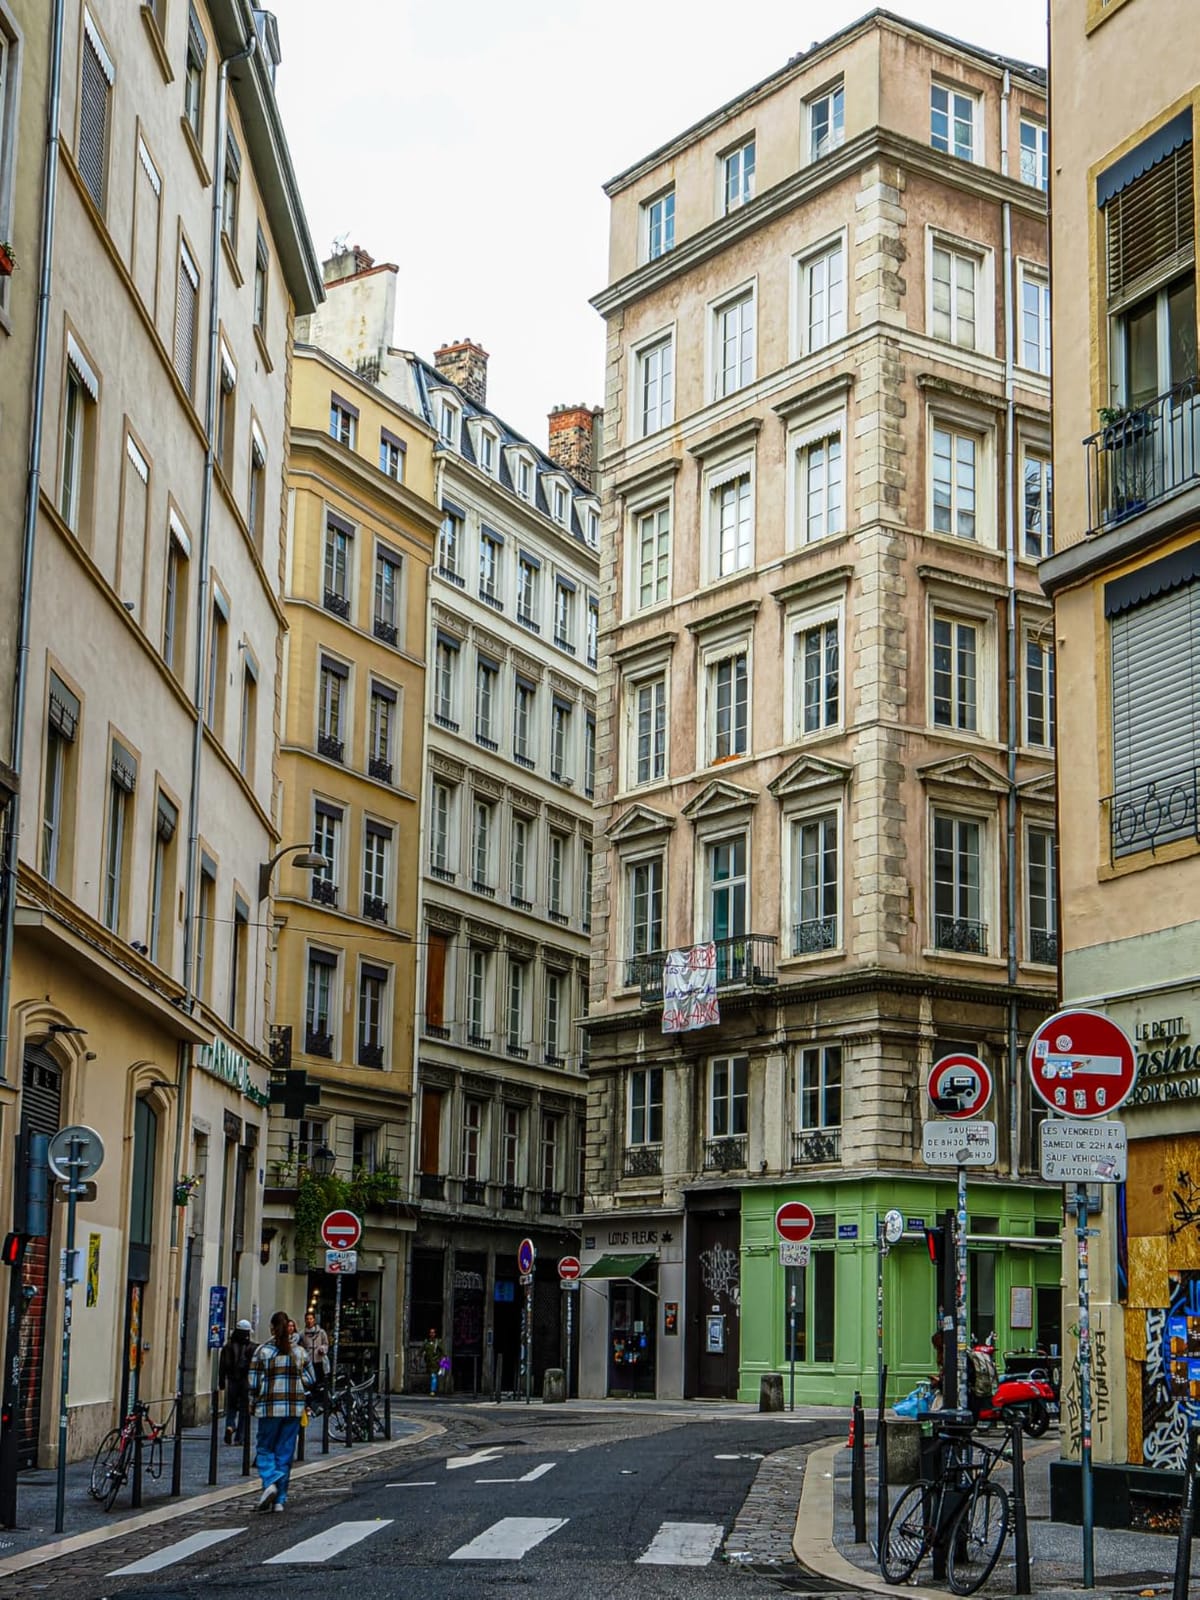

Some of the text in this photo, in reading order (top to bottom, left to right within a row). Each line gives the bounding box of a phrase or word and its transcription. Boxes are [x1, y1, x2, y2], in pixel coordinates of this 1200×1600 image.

[1135, 1016, 1184, 1041] LE PETIT
[1135, 1037, 1200, 1081] asin
[1042, 1127, 1118, 1137] LES VENDREDI ET
[1042, 1140, 1126, 1150] SAMEDI DE 22H A 4H
[925, 1151, 937, 1159] DE
[1046, 1153, 1068, 1162] SAUF
[607, 1231, 629, 1246] LOTUS
[631, 1230, 659, 1245] FLEURS
